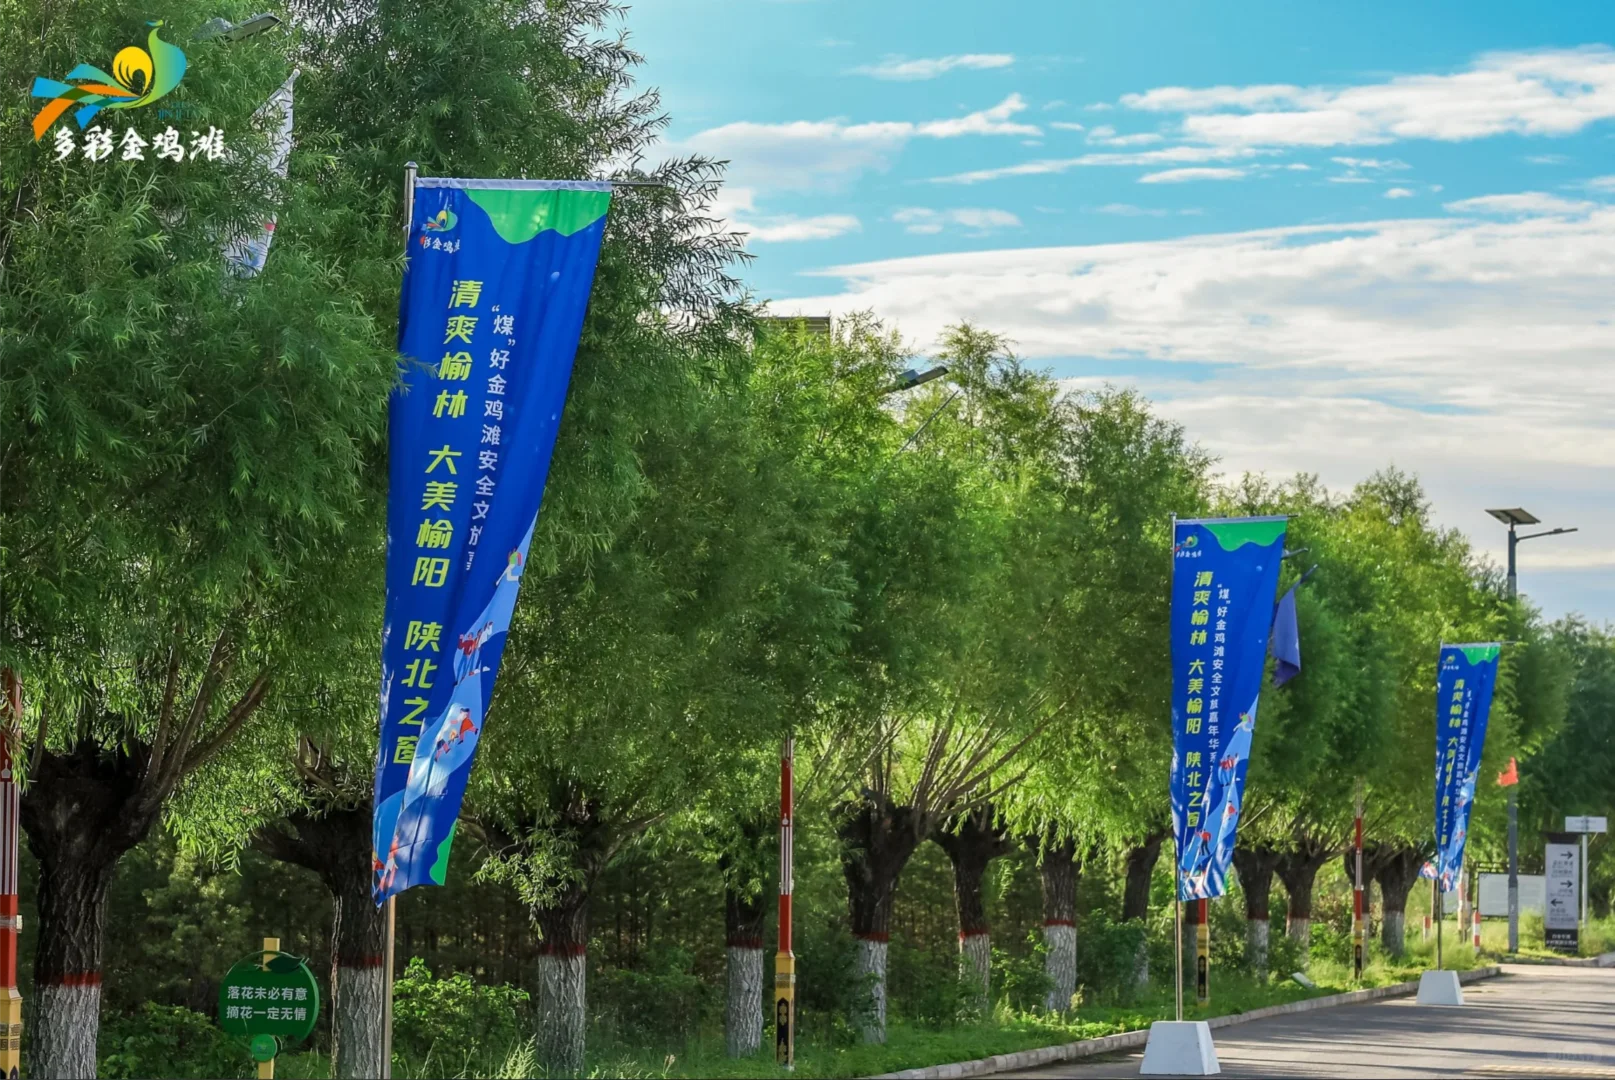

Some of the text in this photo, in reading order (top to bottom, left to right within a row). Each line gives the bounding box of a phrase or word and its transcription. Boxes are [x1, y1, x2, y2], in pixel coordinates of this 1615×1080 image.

[432, 280, 484, 418] 清爽榆林
[411, 445, 463, 587] 大美榆阳
[226, 1005, 307, 1021] 摘花一定无情
[227, 986, 308, 1001] 落花未必有意
